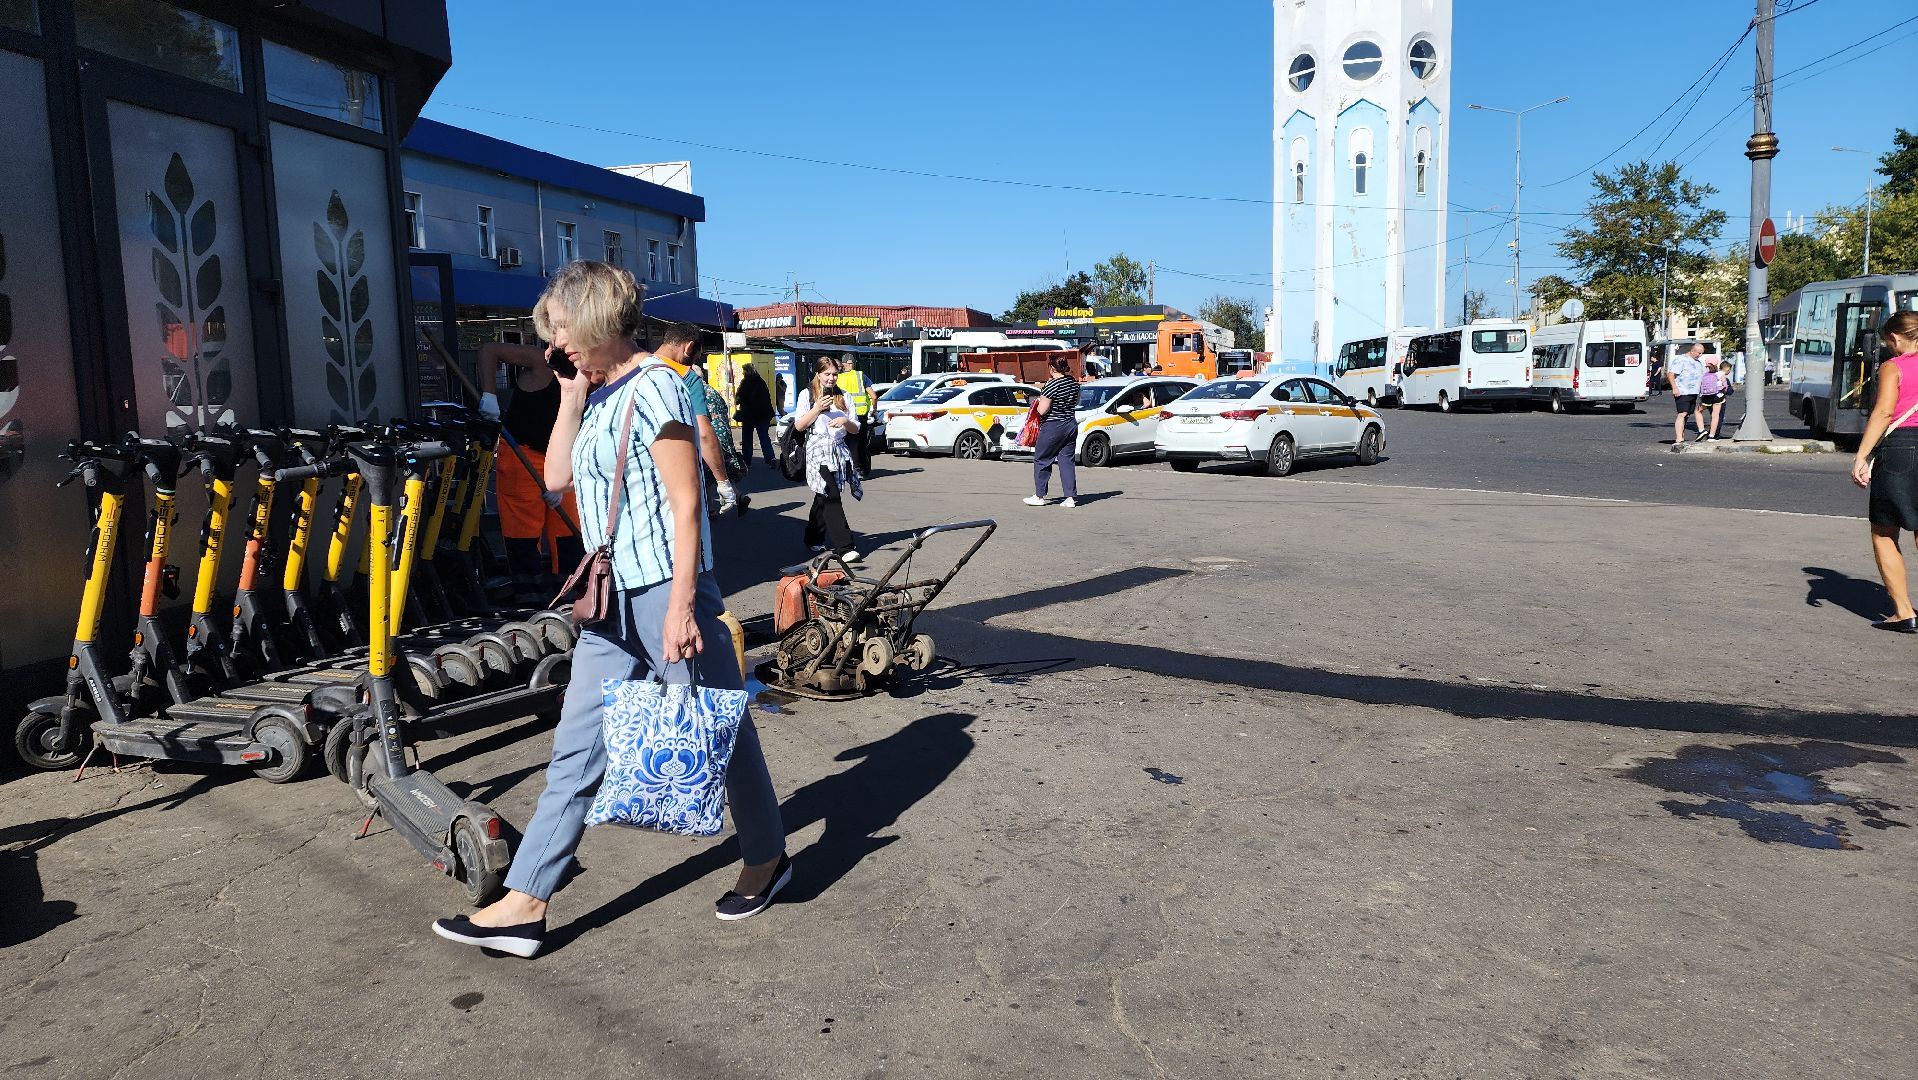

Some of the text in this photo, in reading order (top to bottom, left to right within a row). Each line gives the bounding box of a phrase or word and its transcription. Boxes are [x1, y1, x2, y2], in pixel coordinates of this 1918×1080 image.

[1136, 333, 1157, 341] КАССЫ
[154, 499, 168, 556] WHOOSH
[254, 485, 273, 538] WHOOSH
[405, 508, 418, 552] WHOOSH
[98, 519, 113, 563] WHOOSH
[209, 520, 225, 563] WHOOSH
